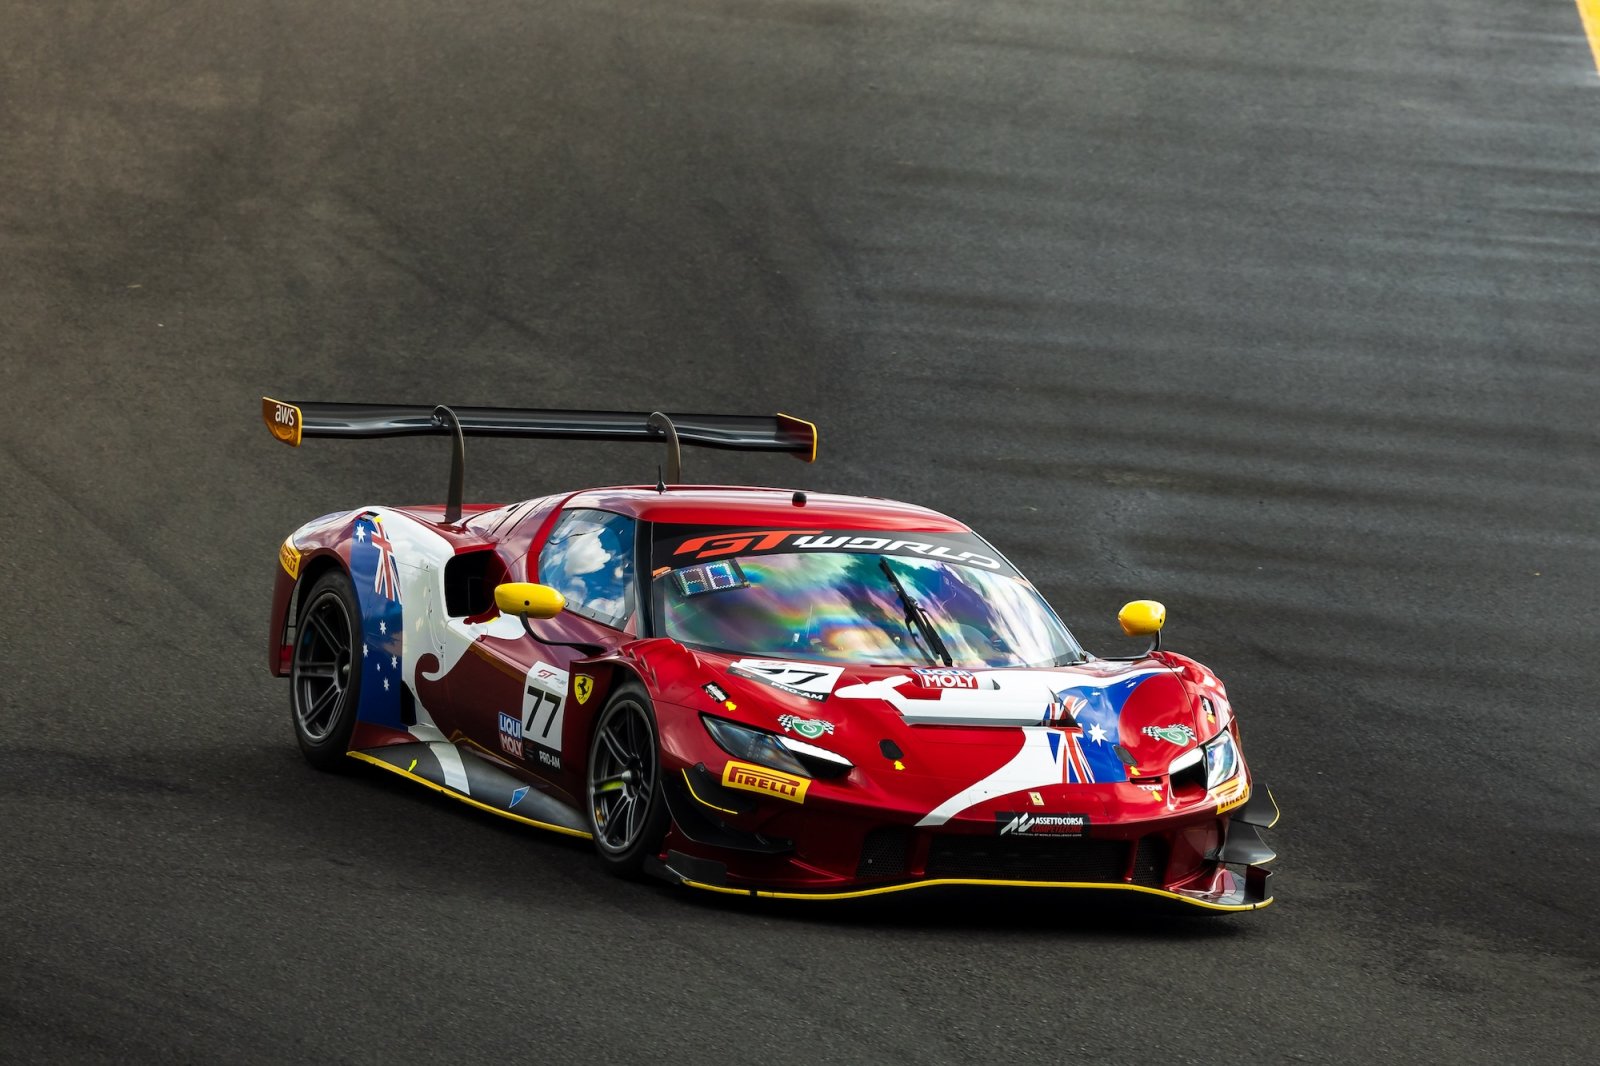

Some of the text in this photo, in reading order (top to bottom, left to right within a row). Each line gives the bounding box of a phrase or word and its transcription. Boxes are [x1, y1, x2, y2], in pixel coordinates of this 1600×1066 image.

[275, 404, 295, 427] aws
[673, 531, 1001, 570] GT WORLD
[771, 682, 824, 701] PRO-AM
[923, 675, 974, 688] MOLY
[525, 685, 562, 738] 77
[499, 714, 521, 739] LIQUI
[500, 733, 522, 757] MOLY
[538, 750, 561, 769] PRO-AM
[728, 766, 801, 797] PIRELLI
